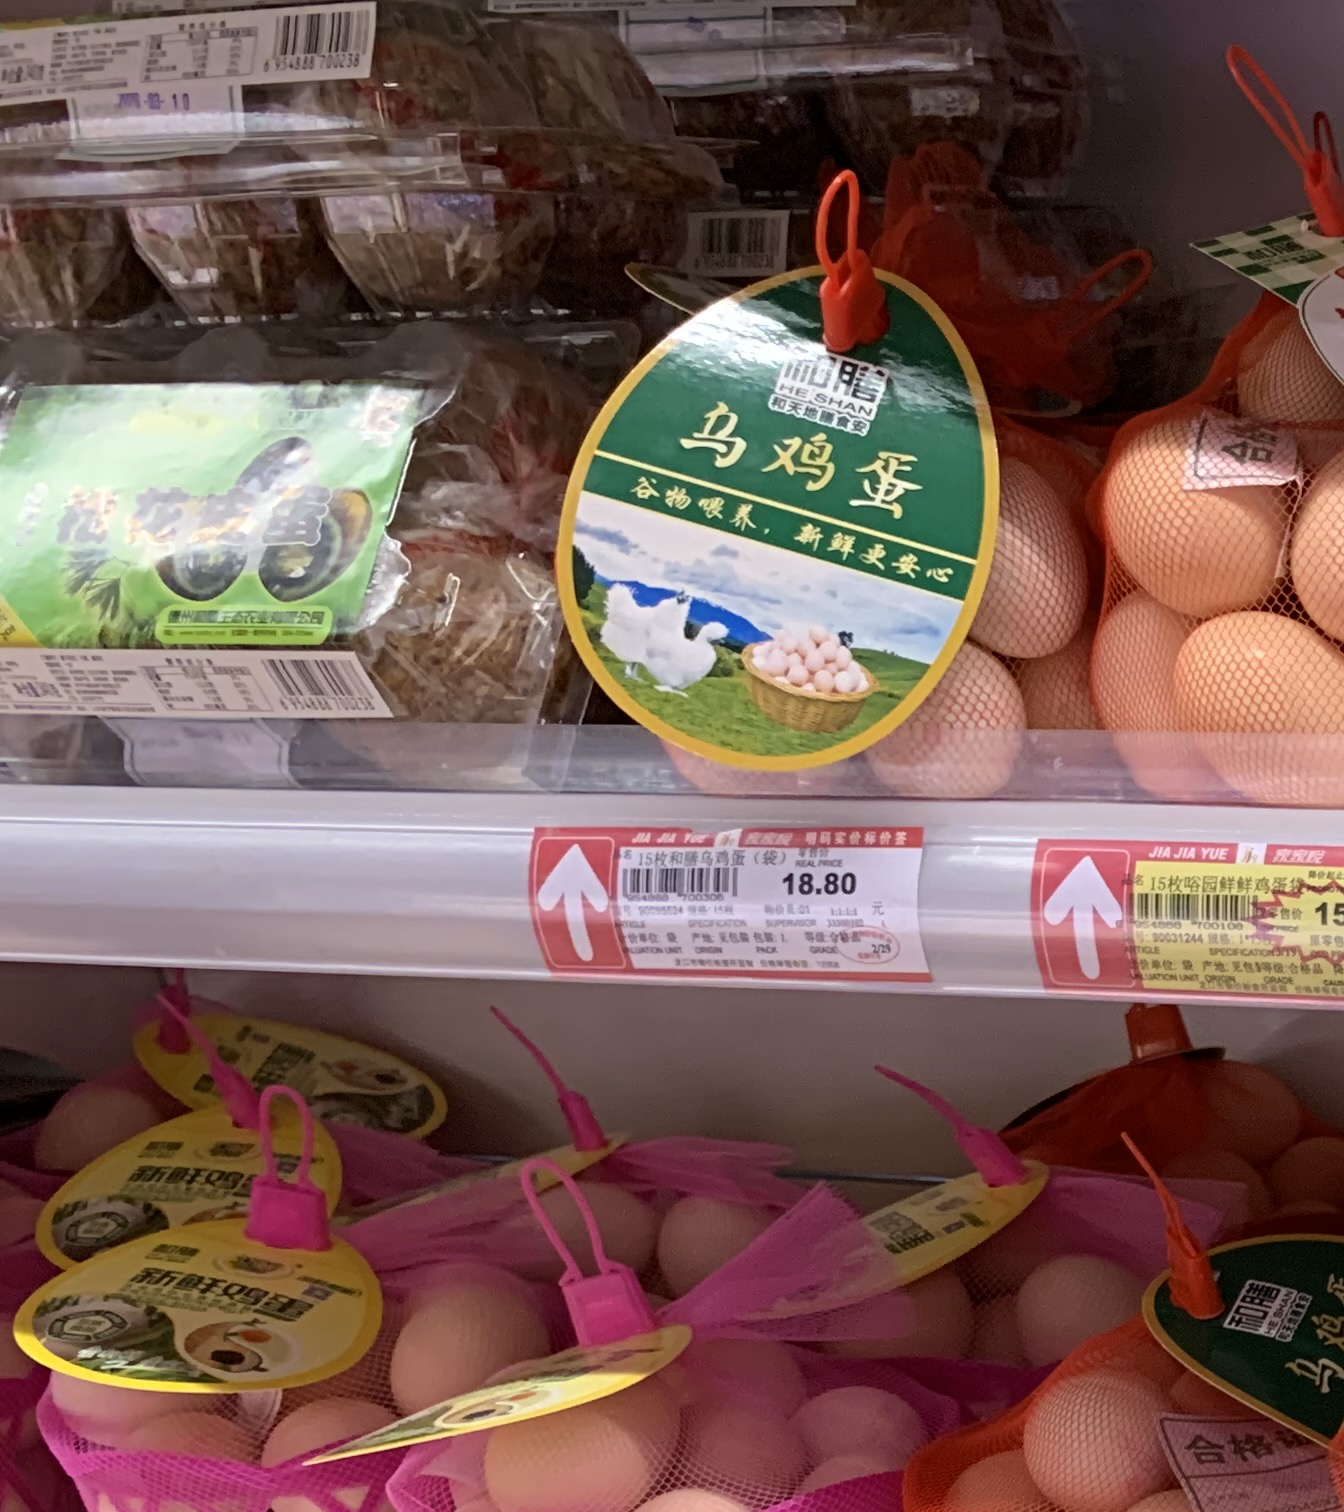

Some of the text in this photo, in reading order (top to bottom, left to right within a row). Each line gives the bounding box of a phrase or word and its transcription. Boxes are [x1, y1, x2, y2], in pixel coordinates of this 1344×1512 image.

[319, 53, 360, 69] 700238
[813, 390, 874, 417] SHAN
[680, 401, 924, 521] 乌鸡蛋
[632, 833, 651, 843] JIA
[657, 833, 677, 843] JIA
[1149, 847, 1170, 859] JIA
[1174, 847, 1196, 859] JIA
[1201, 848, 1229, 860] YUE
[782, 872, 857, 895] 18.80
[872, 901, 884, 915] 元
[1263, 976, 1294, 984] GRADE
[1228, 1283, 1282, 1333] 和膳
